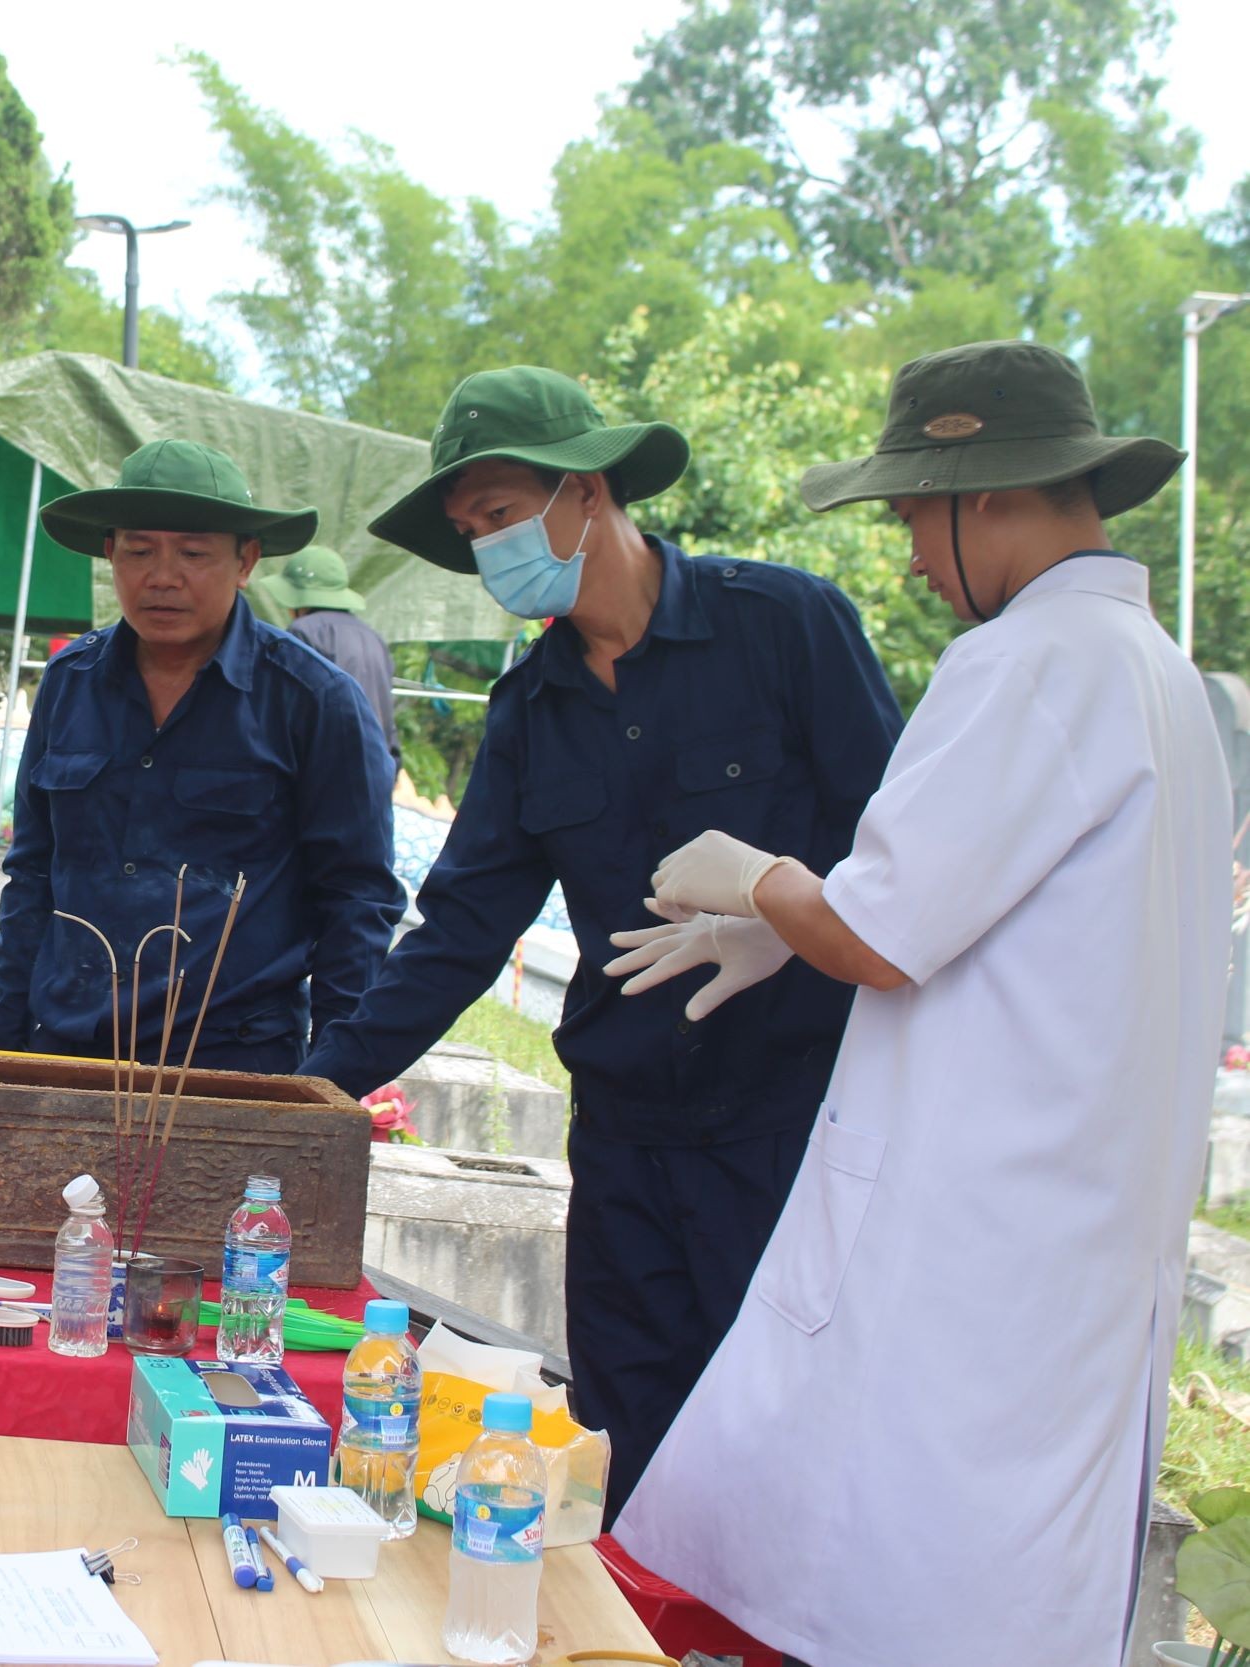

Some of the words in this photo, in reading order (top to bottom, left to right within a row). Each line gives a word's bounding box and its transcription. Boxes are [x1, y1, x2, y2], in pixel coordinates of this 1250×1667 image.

[230, 1433, 254, 1443] LATEX
[255, 1435, 300, 1446] Examination
[302, 1438, 327, 1446] Gloves
[234, 1476, 250, 1484] Single
[260, 1477, 273, 1485] Only
[293, 1469, 316, 1487] M
[234, 1484, 252, 1493] Lightly
